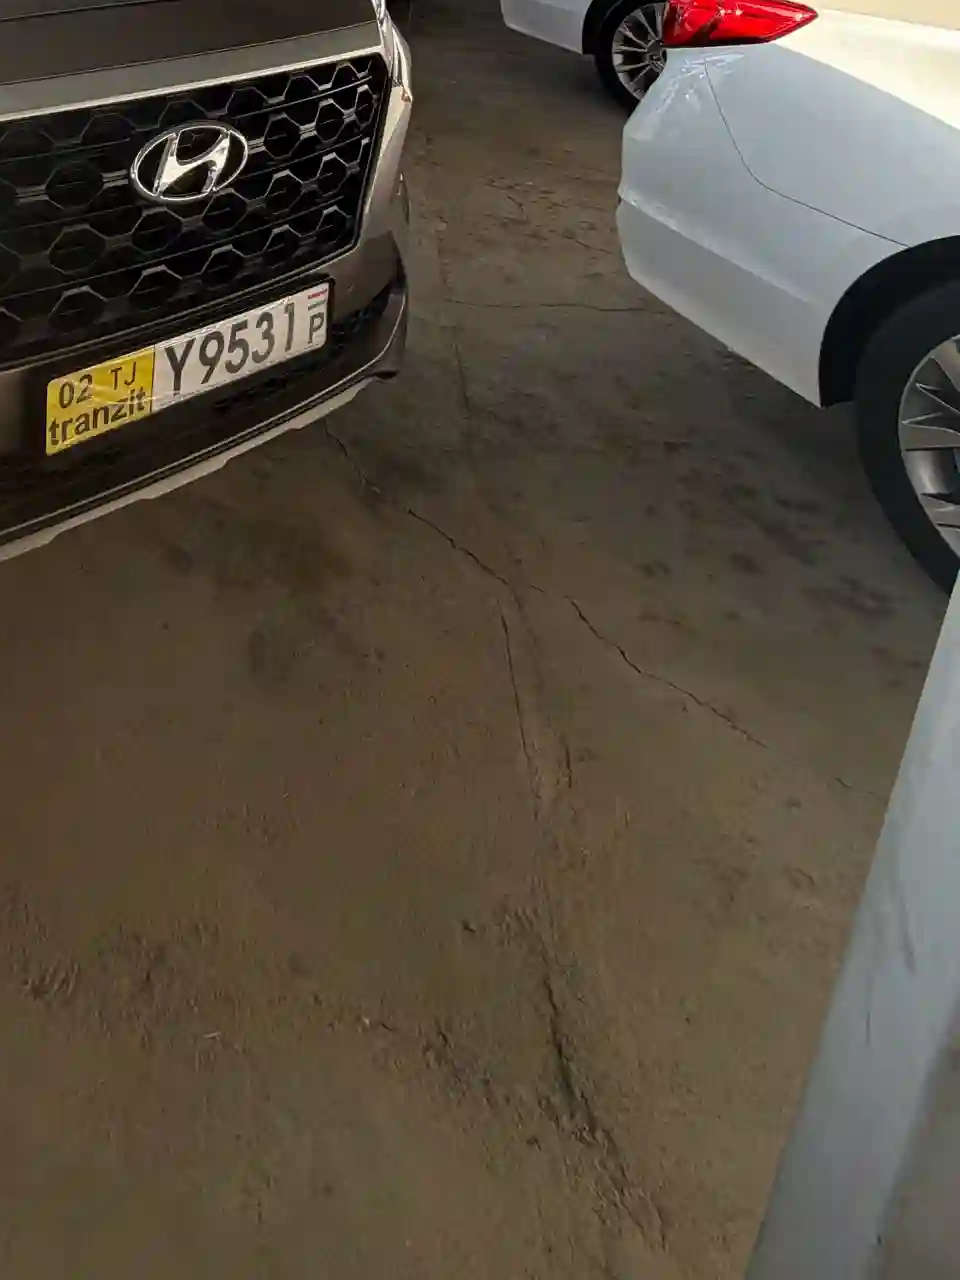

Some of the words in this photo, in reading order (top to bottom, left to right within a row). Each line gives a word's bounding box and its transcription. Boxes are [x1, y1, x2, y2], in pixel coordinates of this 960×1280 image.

[164, 302, 296, 397] Y9531
[308, 311, 325, 345] P
[48, 385, 146, 446] tranzit
[58, 373, 93, 410] 02
[110, 361, 137, 392] TJ
